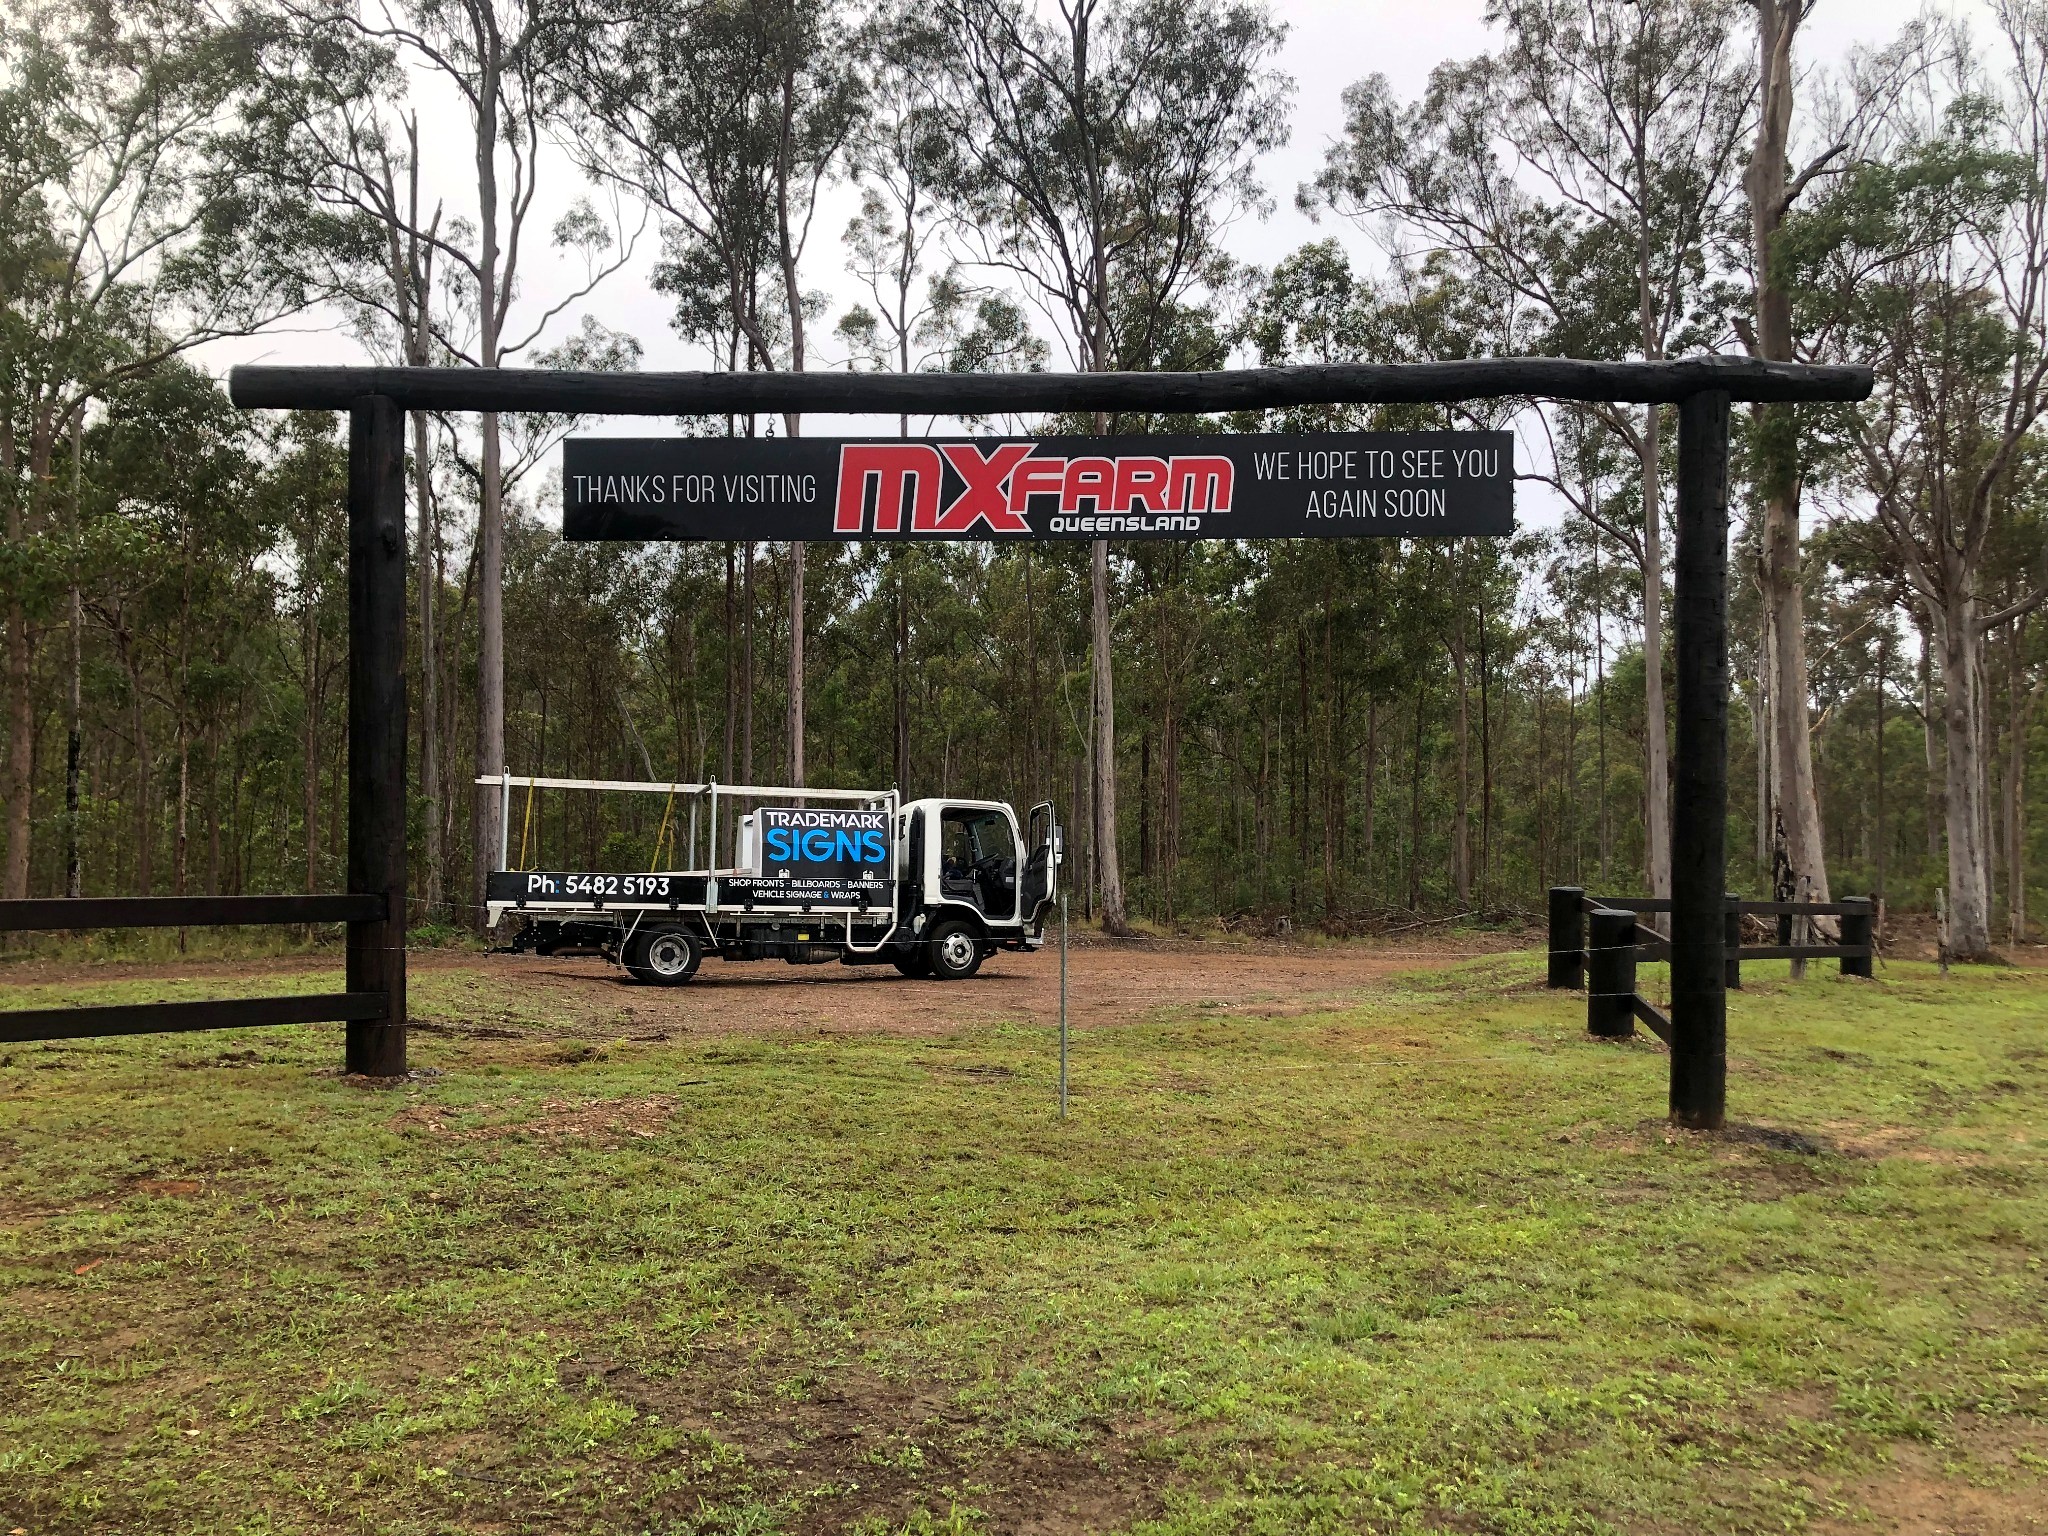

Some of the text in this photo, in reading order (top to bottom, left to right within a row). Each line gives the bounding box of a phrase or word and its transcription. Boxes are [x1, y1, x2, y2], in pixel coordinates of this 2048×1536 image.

[1253, 449, 1498, 480] WE HOPE TO SEE YOU
[572, 474, 817, 503] THANKS FOR VISITING
[1305, 488, 1445, 519] AGAIN SOON
[1049, 516, 1201, 533] QUEENSLAND
[766, 811, 884, 829] TRADEMARK
[766, 828, 886, 863] SIGNS
[527, 874, 670, 896] Ph: 5482 5193
[728, 879, 752, 887] SHOP
[752, 879, 785, 888] FRONTS
[791, 880, 841, 889] BILLBOARDS
[847, 881, 884, 889] BANNERS
[752, 890, 861, 900] VEHICLE SIGNAGE & WRAPS
